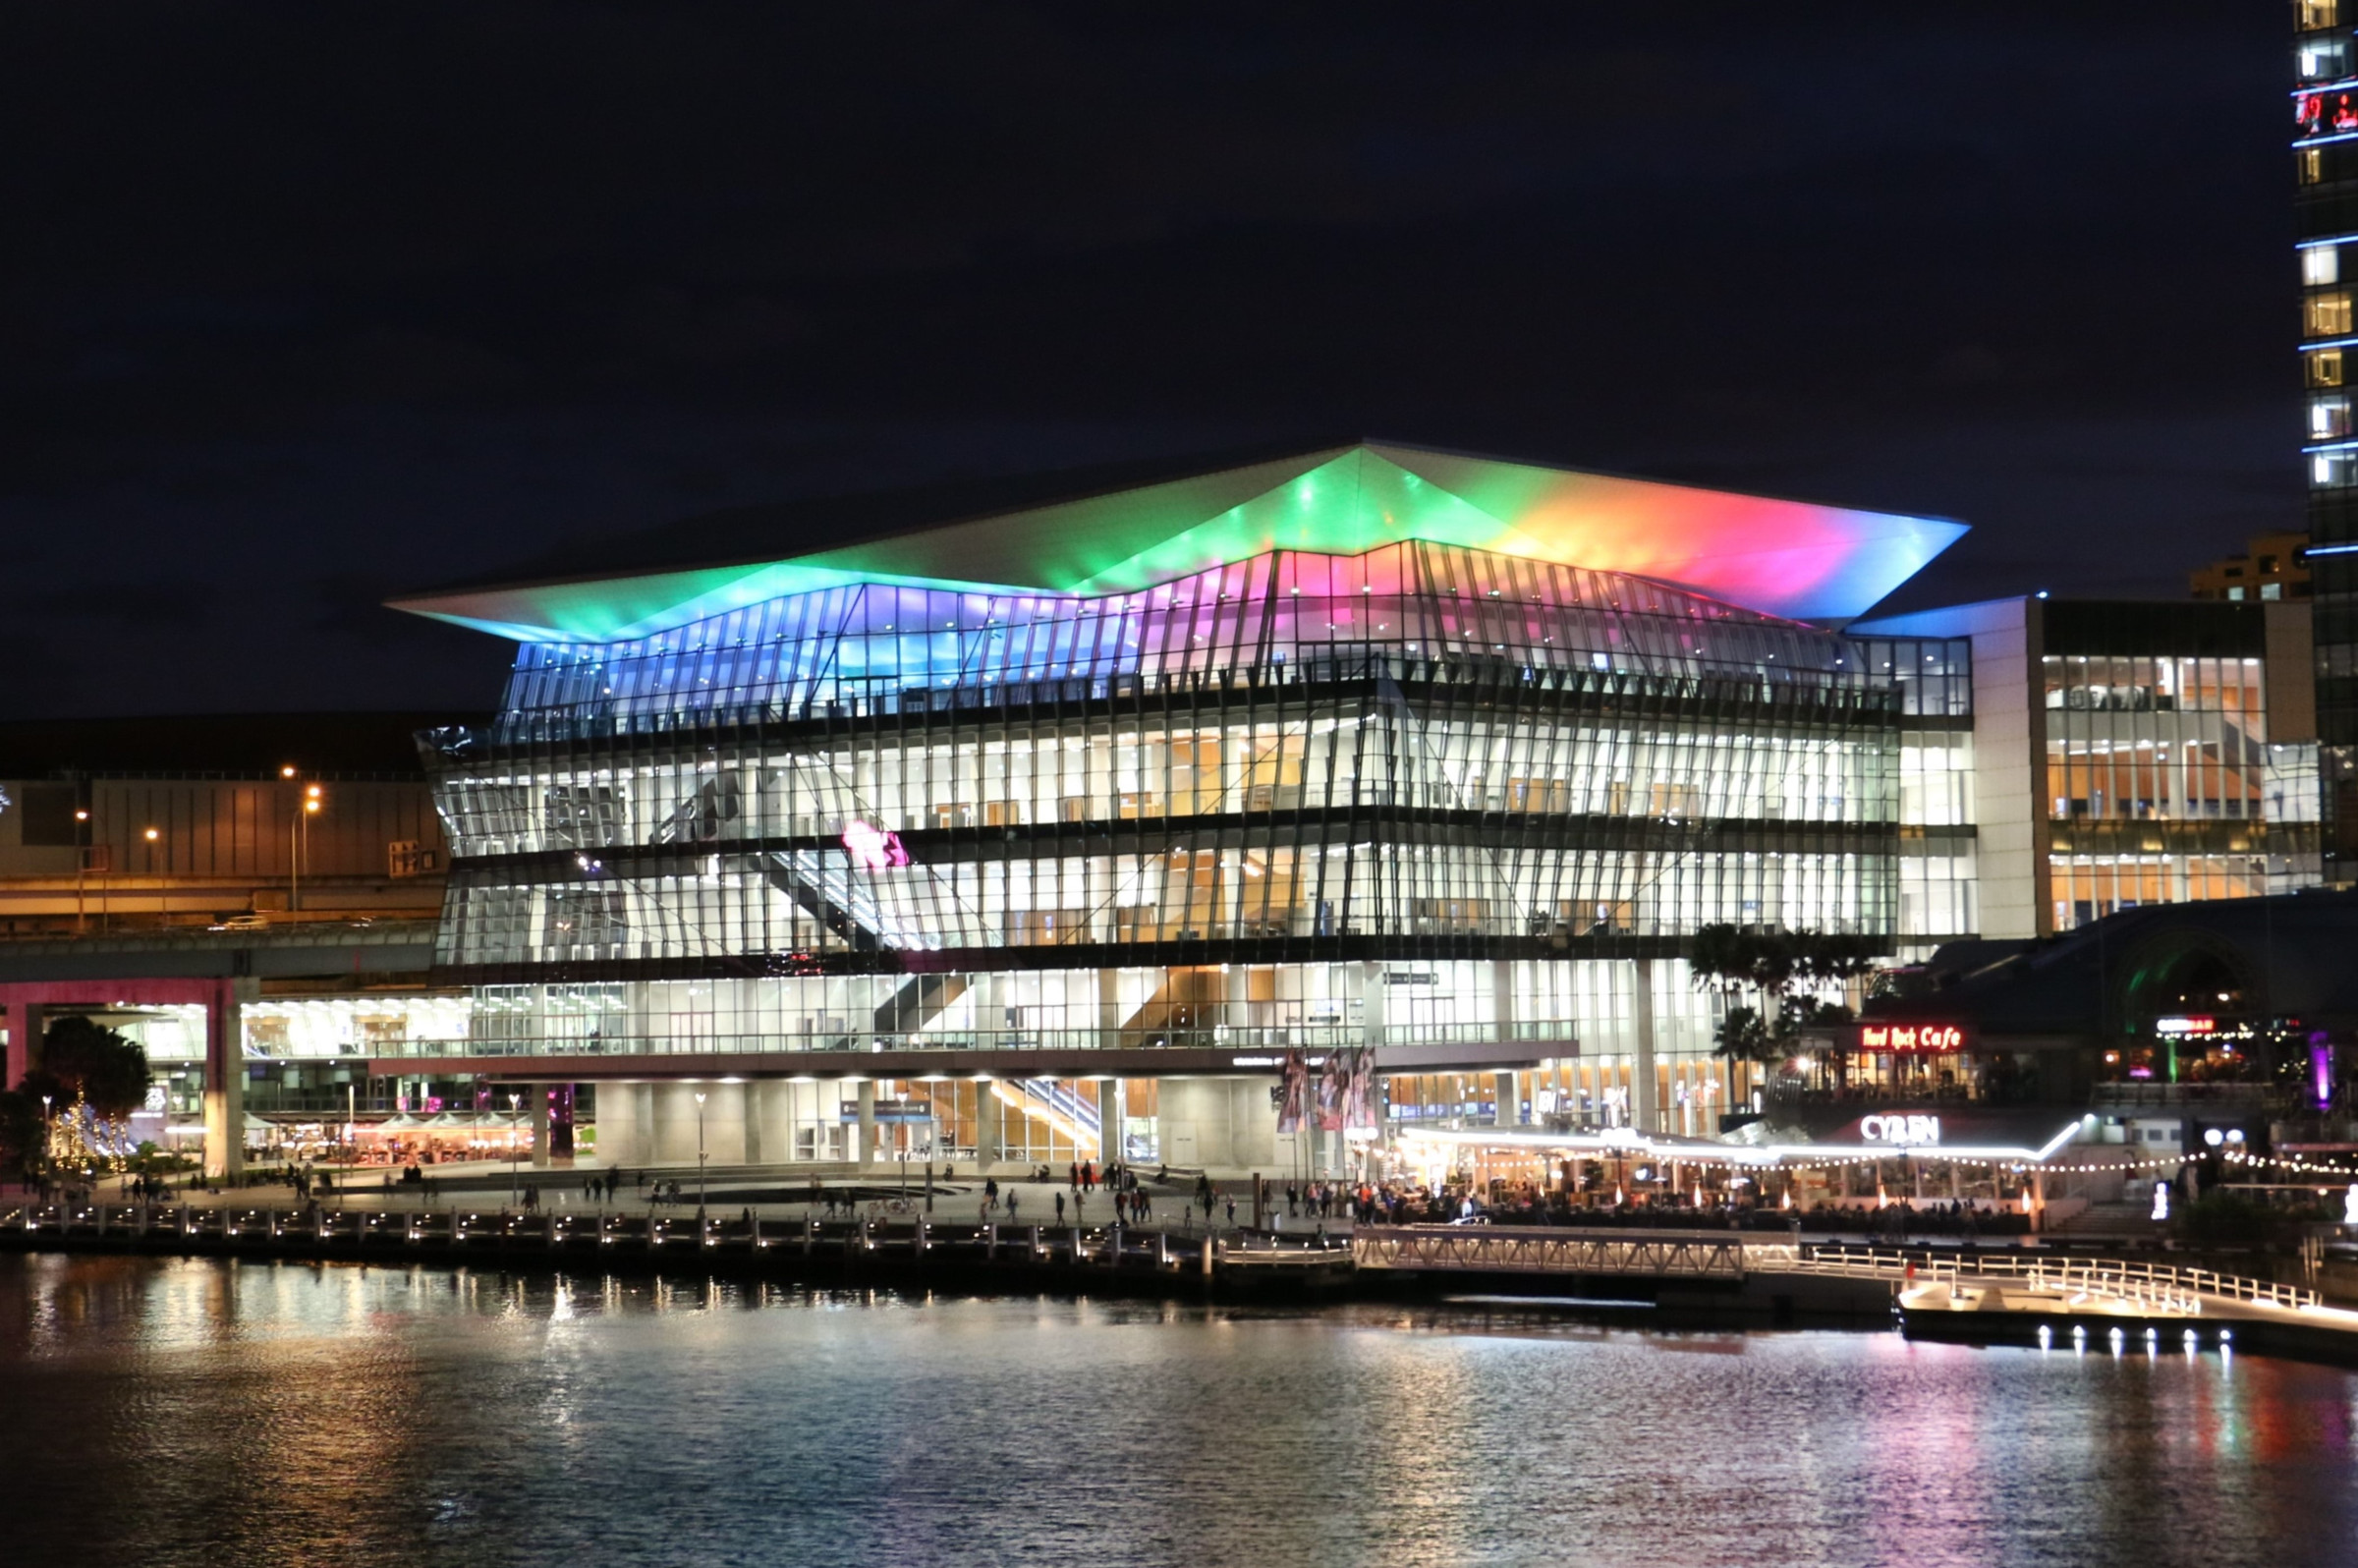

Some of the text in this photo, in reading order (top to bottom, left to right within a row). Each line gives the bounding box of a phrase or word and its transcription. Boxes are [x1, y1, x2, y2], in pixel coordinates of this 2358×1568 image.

[1863, 1026, 1961, 1050] Hard Rock Cafe
